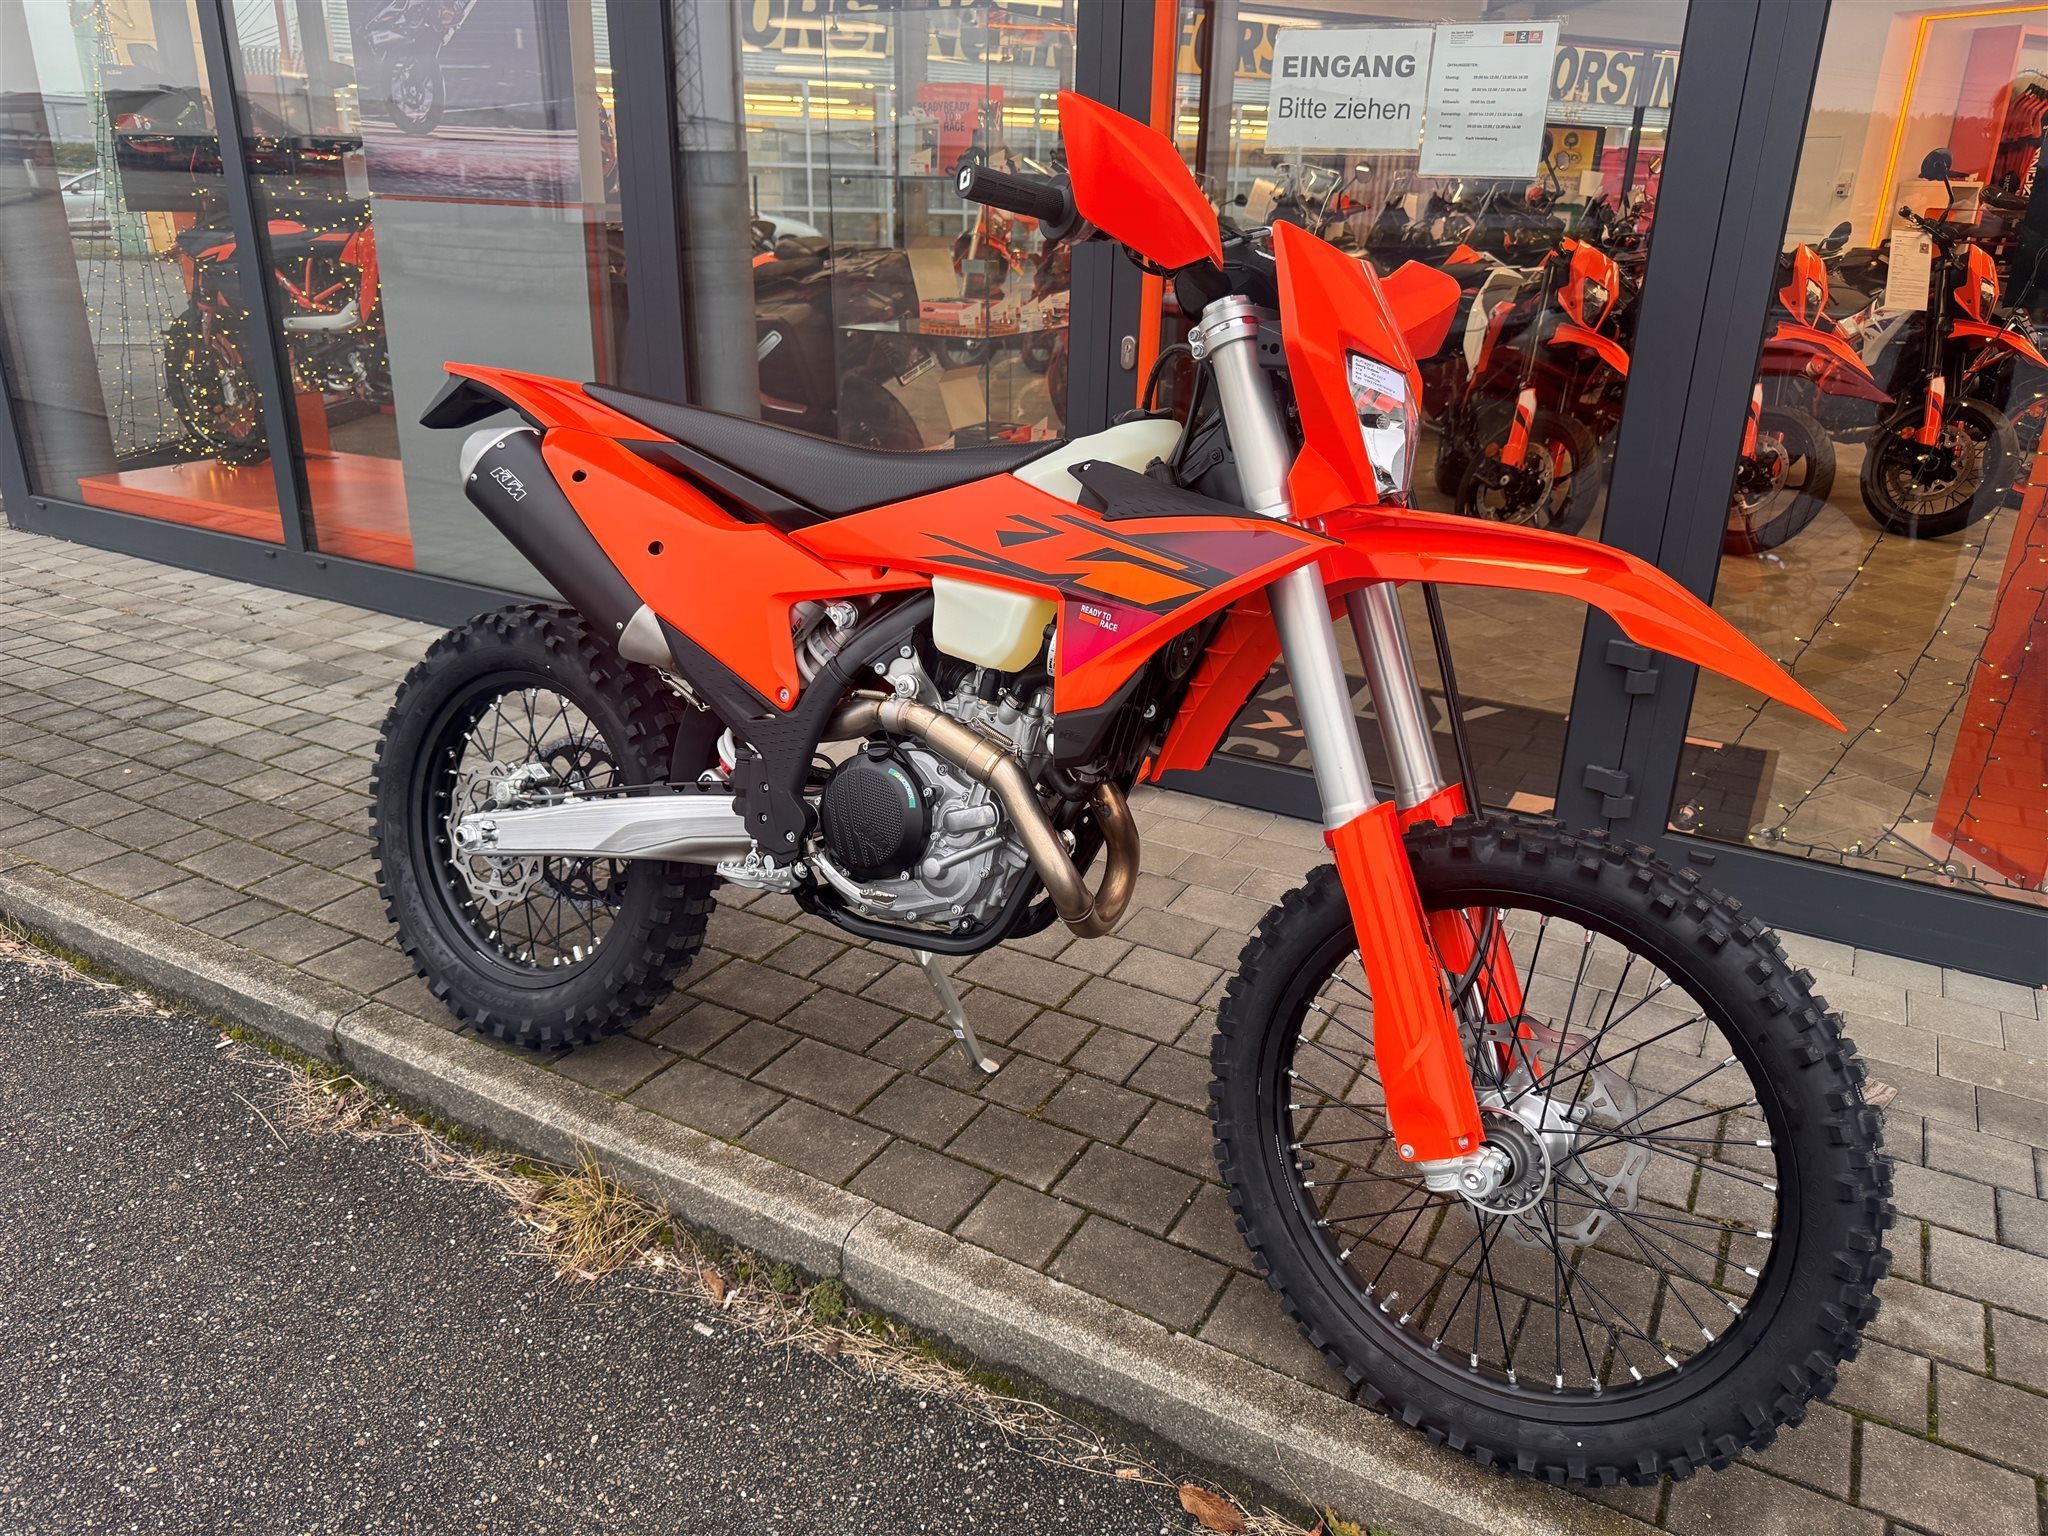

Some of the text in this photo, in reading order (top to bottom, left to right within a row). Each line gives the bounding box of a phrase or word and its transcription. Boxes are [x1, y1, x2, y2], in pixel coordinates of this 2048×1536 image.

[1282, 54, 1416, 78] EINGANG
[944, 101, 970, 113] READY
[1278, 97, 1411, 120] Bitte ziehen
[945, 112, 954, 122] TO
[944, 121, 966, 132] RACE
[490, 466, 528, 502] KTM
[1080, 604, 1112, 622] READY TO
[1099, 619, 1118, 633] RACE
